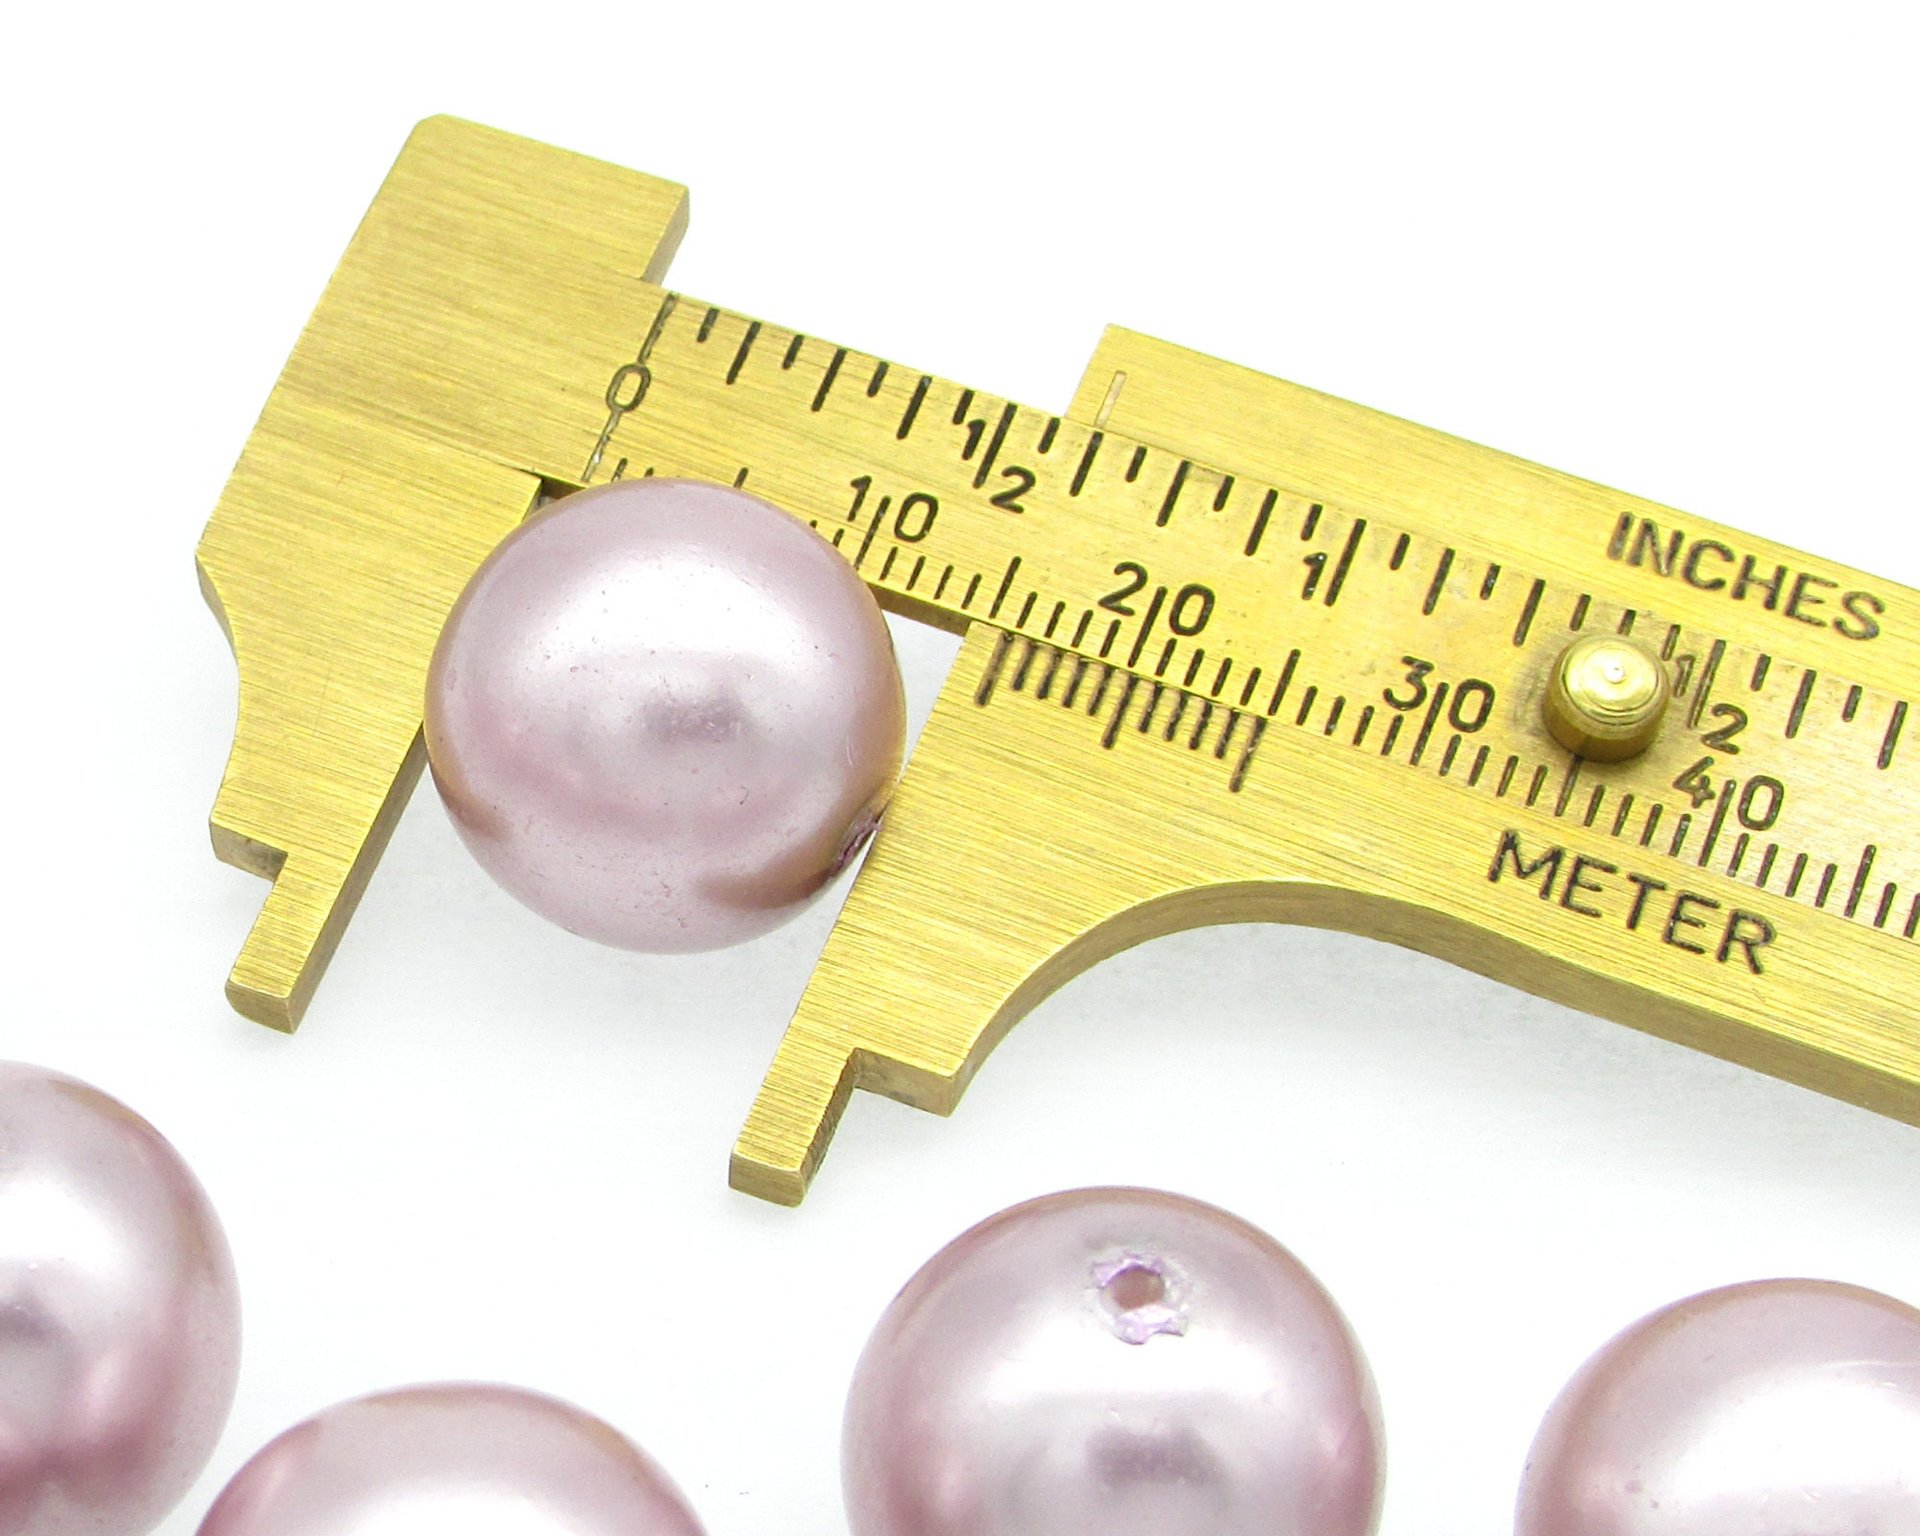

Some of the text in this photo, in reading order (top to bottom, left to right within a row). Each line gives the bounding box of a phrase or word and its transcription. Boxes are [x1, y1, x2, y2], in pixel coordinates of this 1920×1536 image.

[605, 362, 651, 412] 0
[1099, 561, 1216, 637] 20
[1301, 552, 1328, 601] 1
[1607, 511, 1886, 640] INCHES
[1382, 655, 1496, 733] 30
[1673, 756, 1785, 831] 40
[1488, 829, 1777, 975] METER
